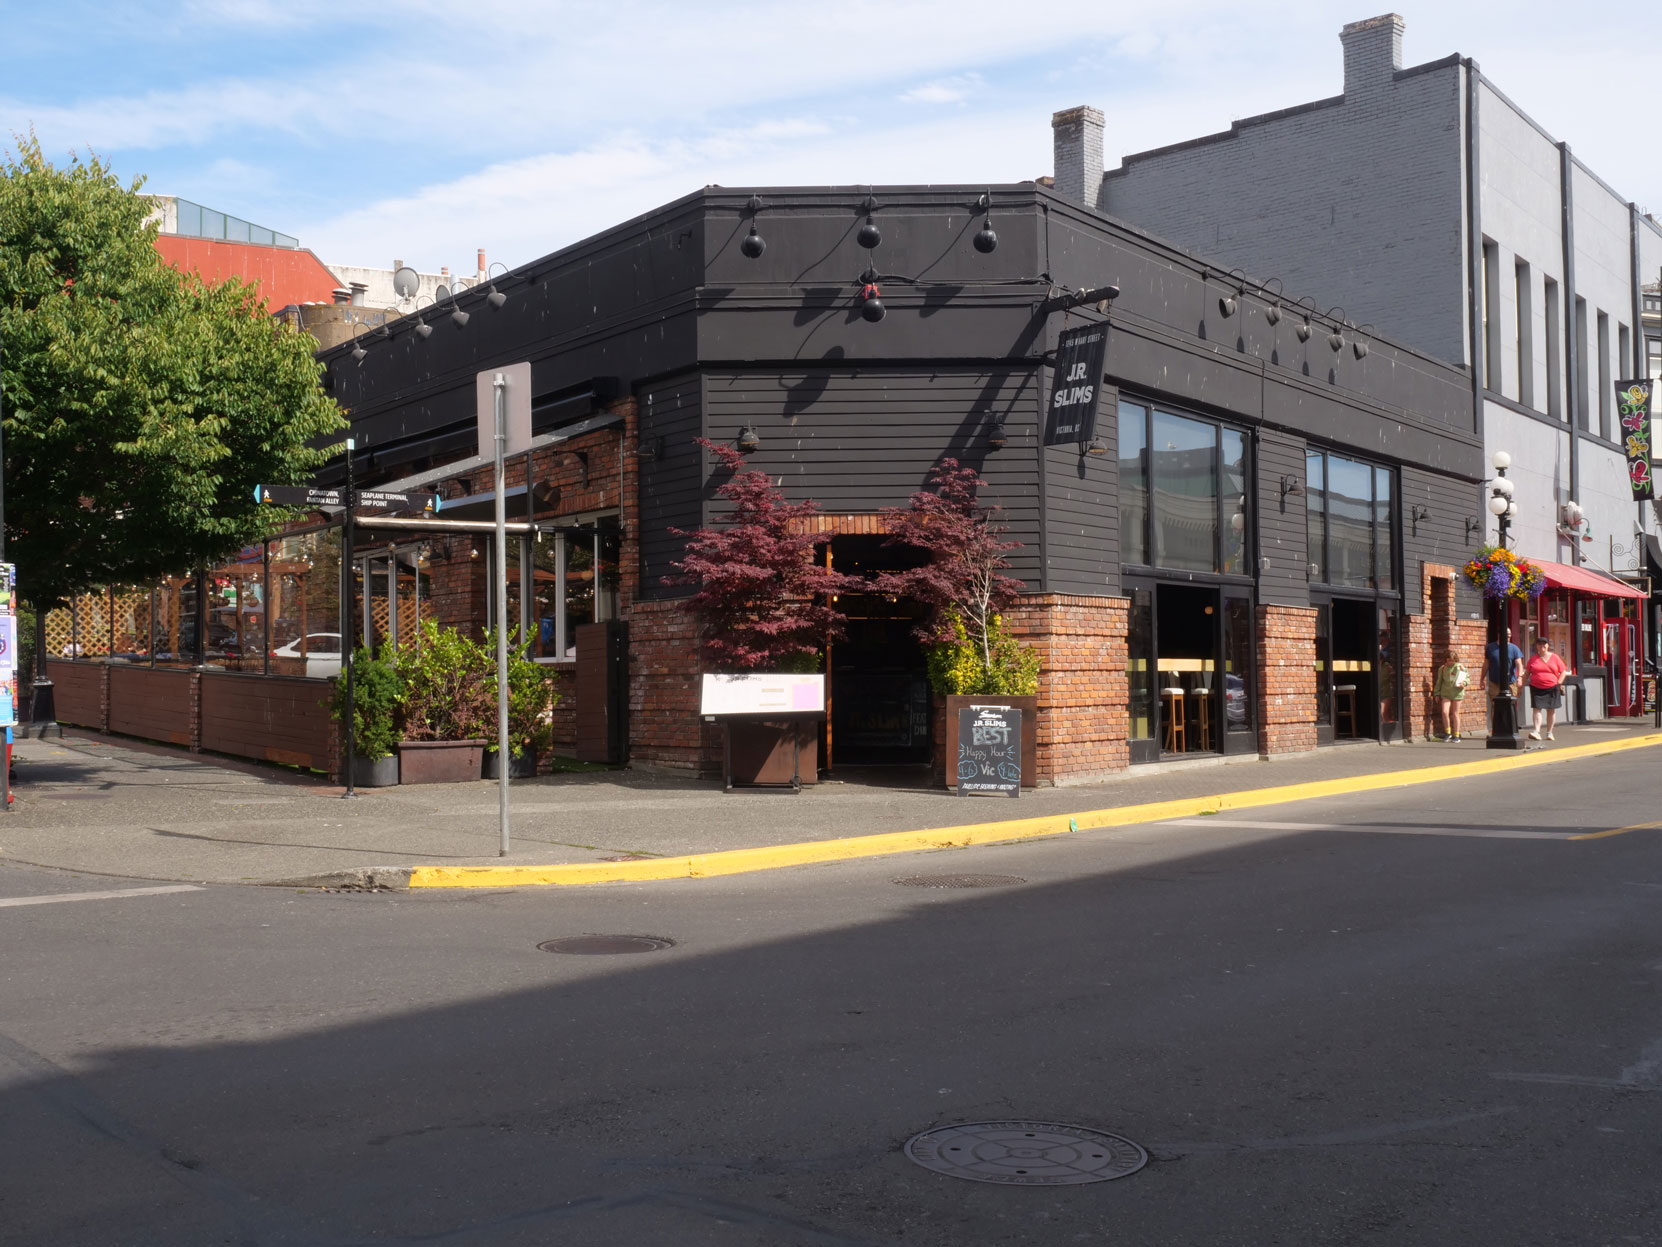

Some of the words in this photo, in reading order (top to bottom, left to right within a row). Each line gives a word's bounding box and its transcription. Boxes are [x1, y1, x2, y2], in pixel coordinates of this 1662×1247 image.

[1053, 385, 1094, 408] SLIMS
[361, 491, 384, 500] SEAPLANE
[972, 727, 1012, 746] BEST
[966, 746, 987, 760] Happy
[990, 746, 1007, 758] Hour
